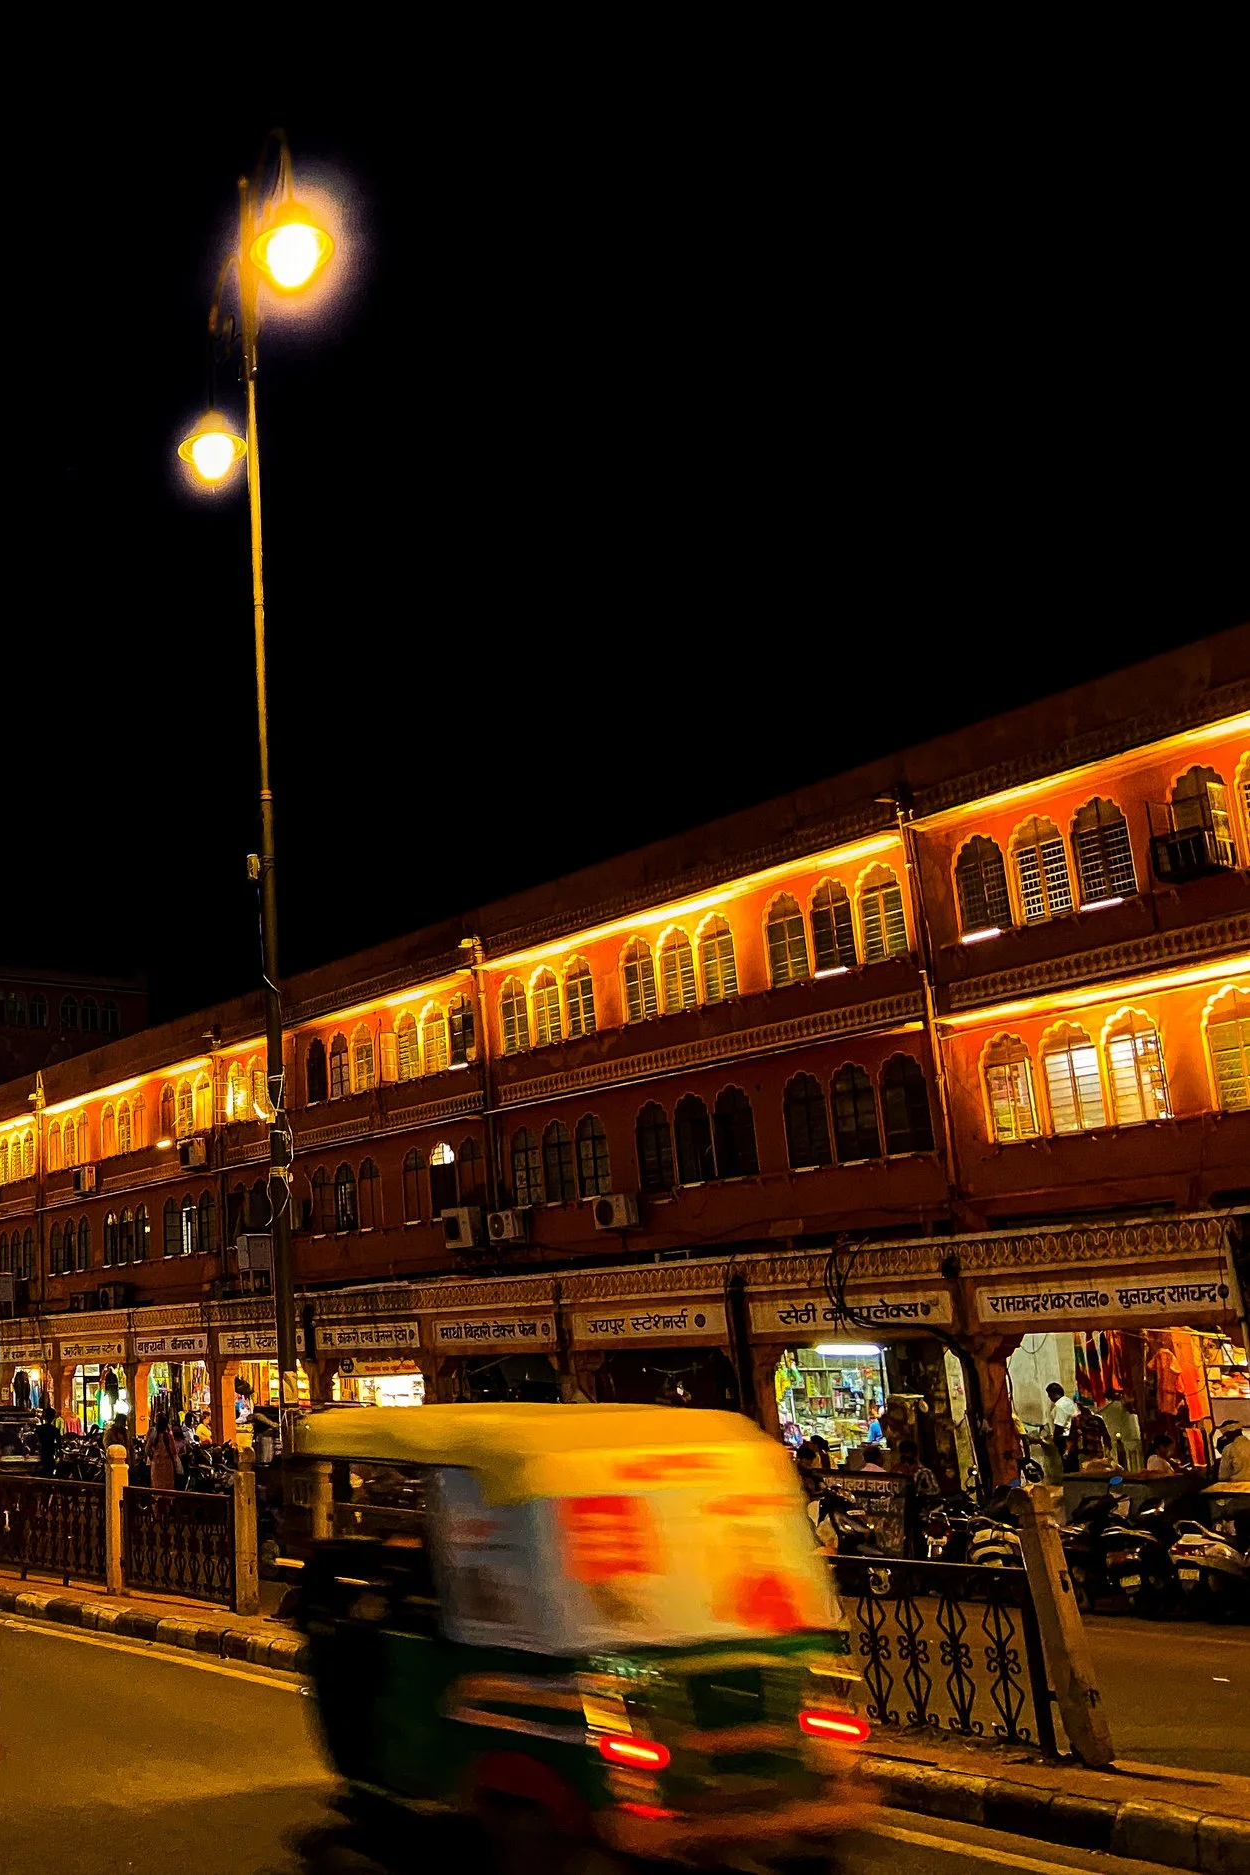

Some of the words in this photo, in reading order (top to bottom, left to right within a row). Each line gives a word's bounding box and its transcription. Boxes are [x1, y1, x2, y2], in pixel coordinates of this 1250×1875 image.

[588, 1318, 625, 1335] जयपुर
[630, 1308, 688, 1331] स्टेशनर्स
[777, 1302, 817, 1325] सेठी
